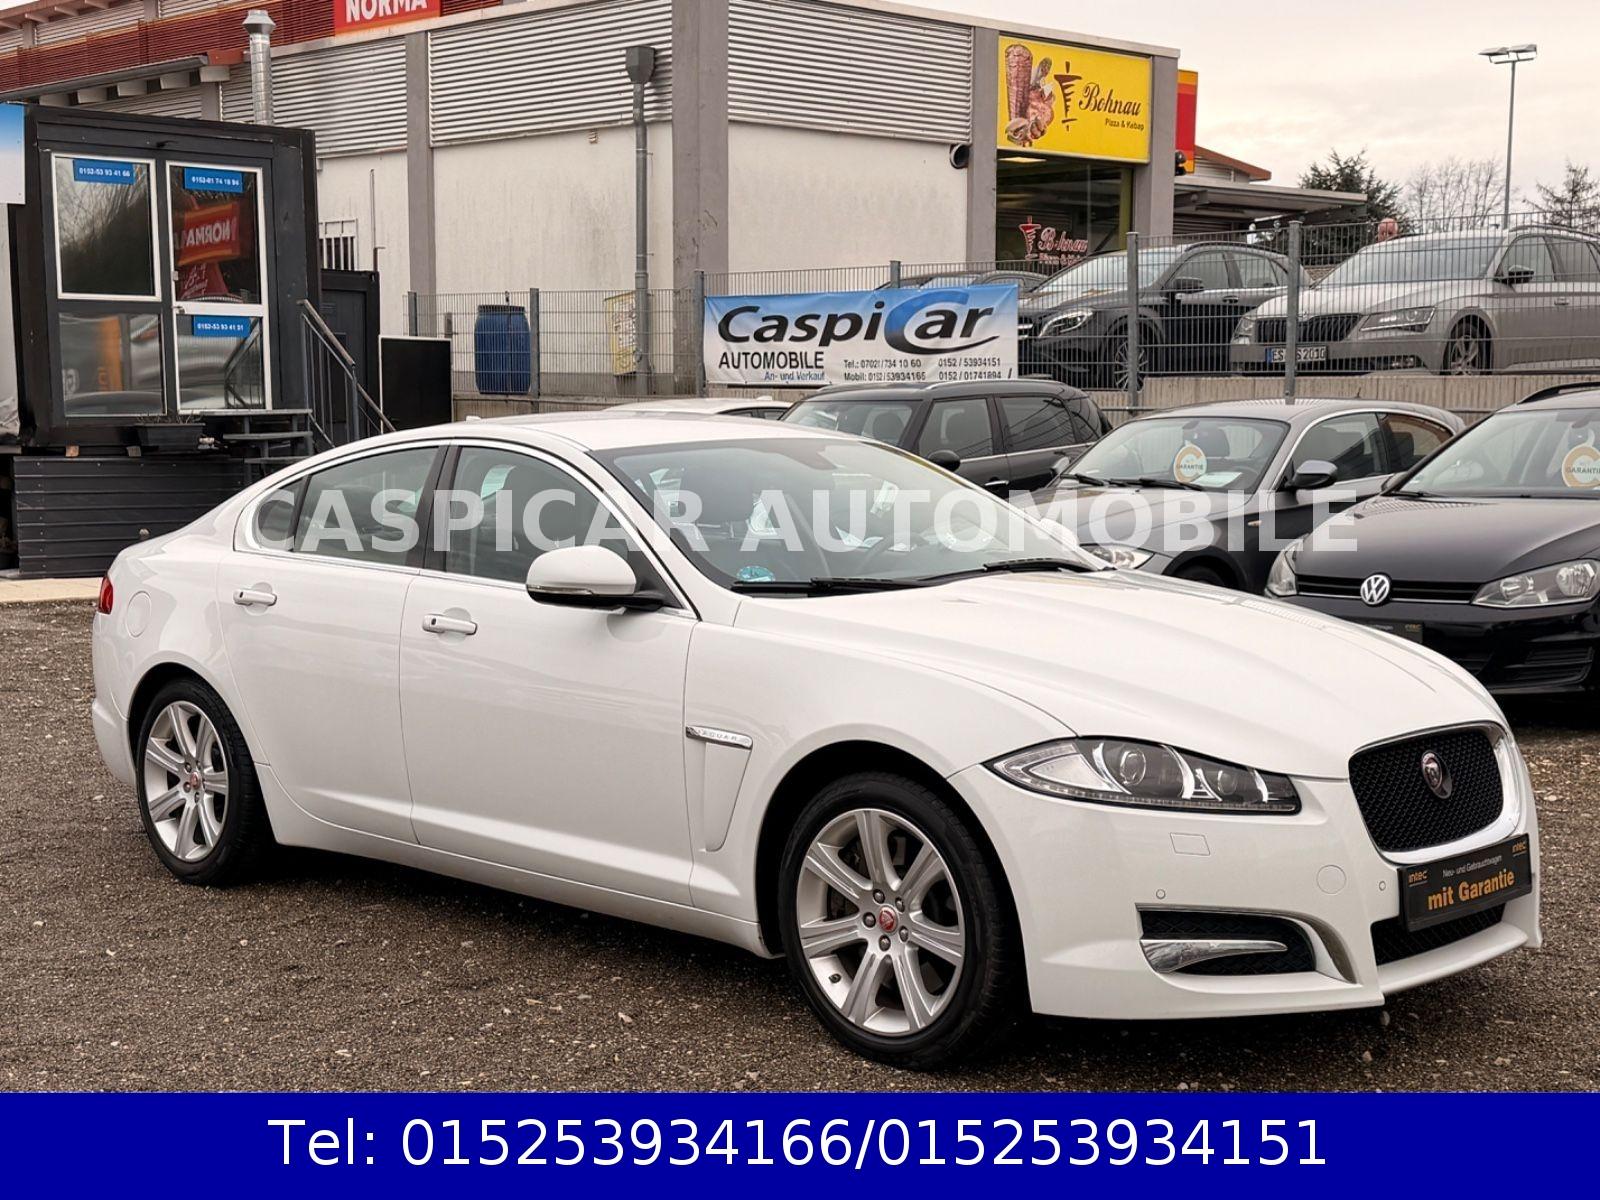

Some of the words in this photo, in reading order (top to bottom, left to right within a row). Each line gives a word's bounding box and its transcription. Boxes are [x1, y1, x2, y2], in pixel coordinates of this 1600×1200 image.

[1079, 82, 1141, 116] Bohnau
[1105, 118, 1120, 127] Pizza
[1121, 120, 1126, 128] &
[718, 290, 999, 354] CaspiCar
[719, 351, 824, 369] AUTOMOBILE
[844, 360, 860, 368] Tel.:
[899, 359, 909, 368] 10
[910, 358, 922, 368] 60
[938, 358, 958, 367] 0152
[764, 372, 778, 380] An-
[780, 370, 794, 380] und
[796, 370, 826, 380] Verkauf
[844, 372, 867, 381] Mobil:
[938, 371, 958, 380] 0152
[1428, 886, 1454, 911] mit
[1458, 868, 1515, 902] Garantie
